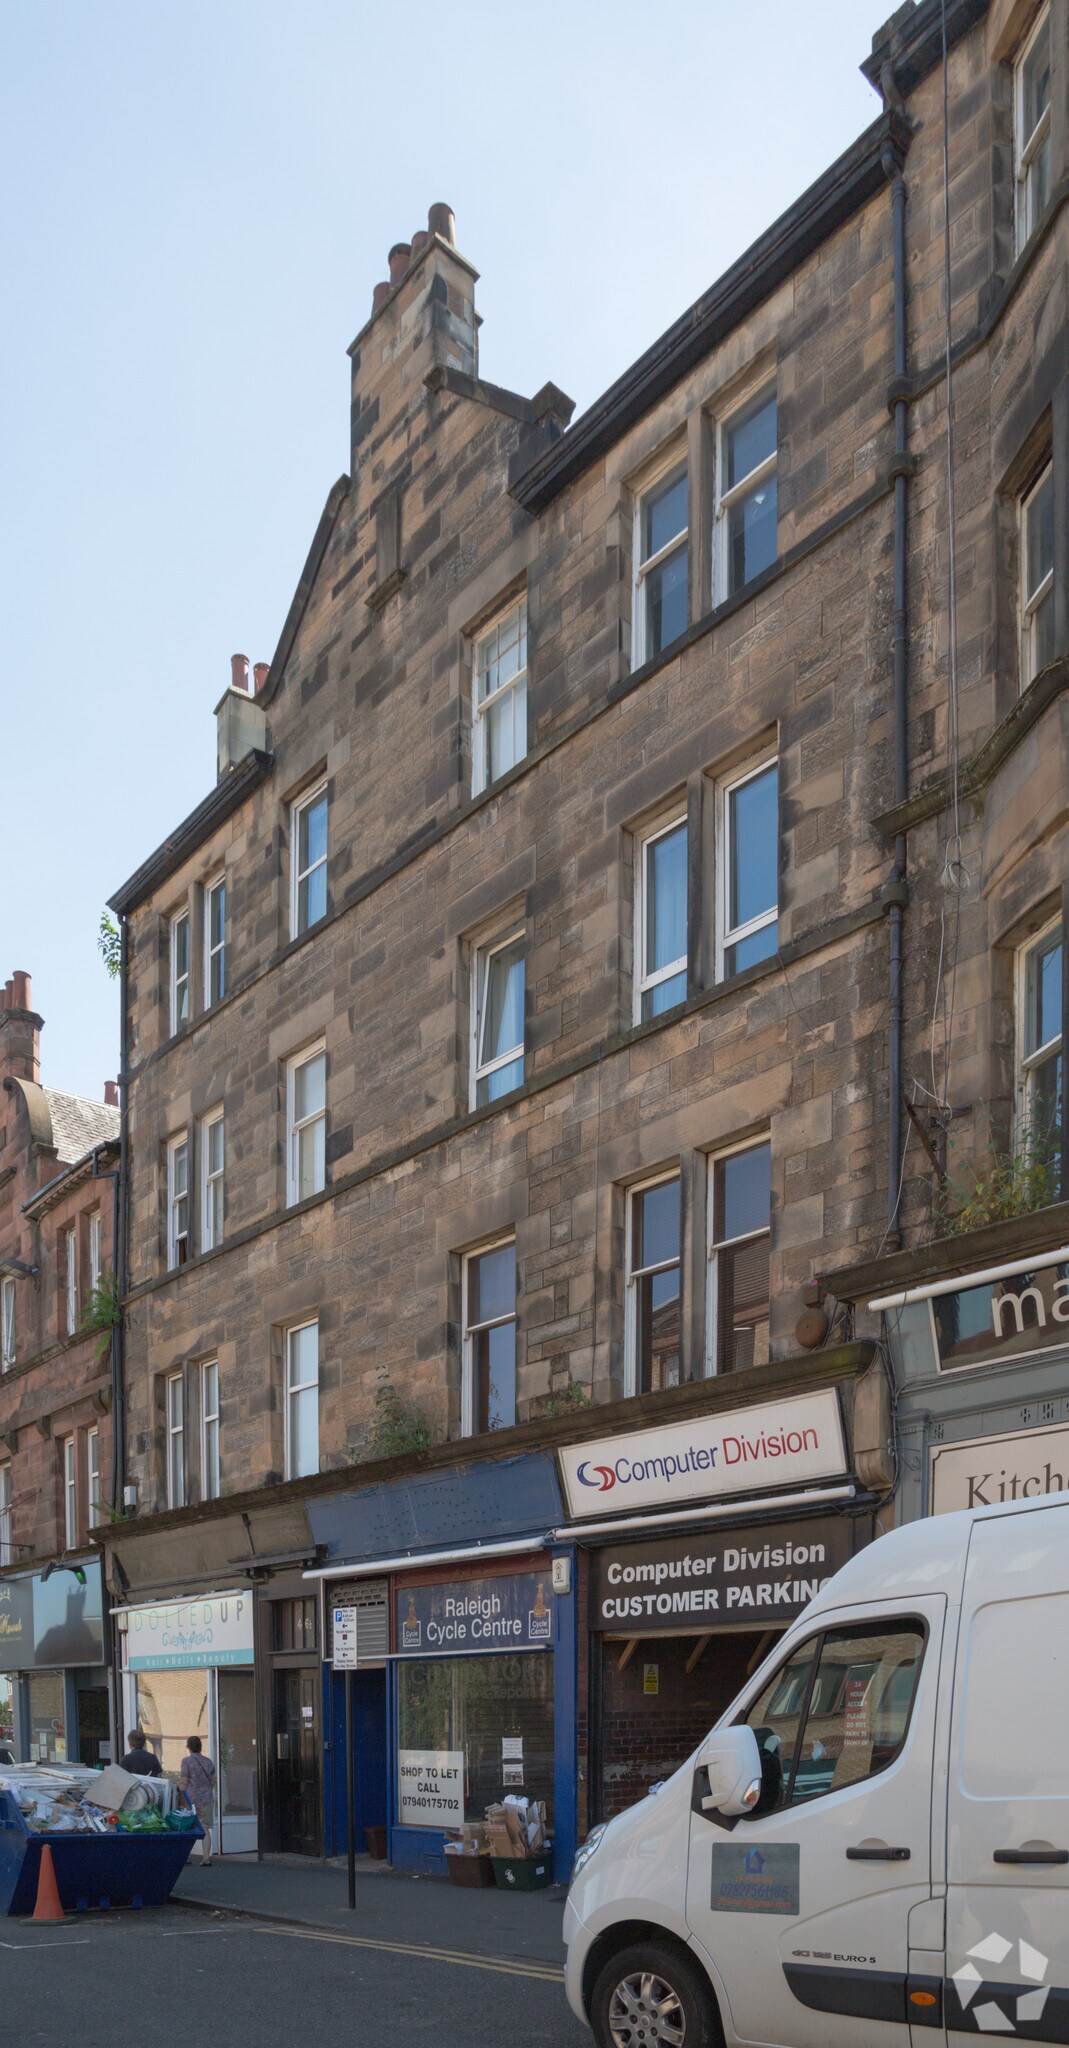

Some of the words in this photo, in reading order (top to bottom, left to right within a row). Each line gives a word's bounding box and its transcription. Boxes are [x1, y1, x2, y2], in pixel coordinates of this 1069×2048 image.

[615, 1446, 718, 1483] Computer
[722, 1427, 819, 1466] Division
[965, 1462, 1069, 1511] Kitch
[607, 1554, 717, 1586] Computer
[723, 1542, 826, 1573] Division
[445, 1594, 501, 1619] Raleigh
[602, 1588, 720, 1619] CUSTOMER
[426, 1620, 467, 1645] Cycle
[471, 1618, 522, 1638] Centre
[530, 1627, 549, 1636] Centre
[531, 1620, 547, 1630] Cycle
[405, 1630, 418, 1638] Cycle
[405, 1636, 419, 1644] Centre
[145, 1657, 163, 1667] Hair
[172, 1656, 194, 1666] Nails
[203, 1653, 235, 1664] Beauty
[400, 1766, 423, 1777] SHOP
[426, 1767, 438, 1778] TO
[441, 1768, 459, 1779] LET
[417, 1782, 440, 1793] CALL
[402, 1795, 459, 1810] 07940175702
[833, 1954, 867, 1963] EURO
[869, 1956, 877, 1964] 5
